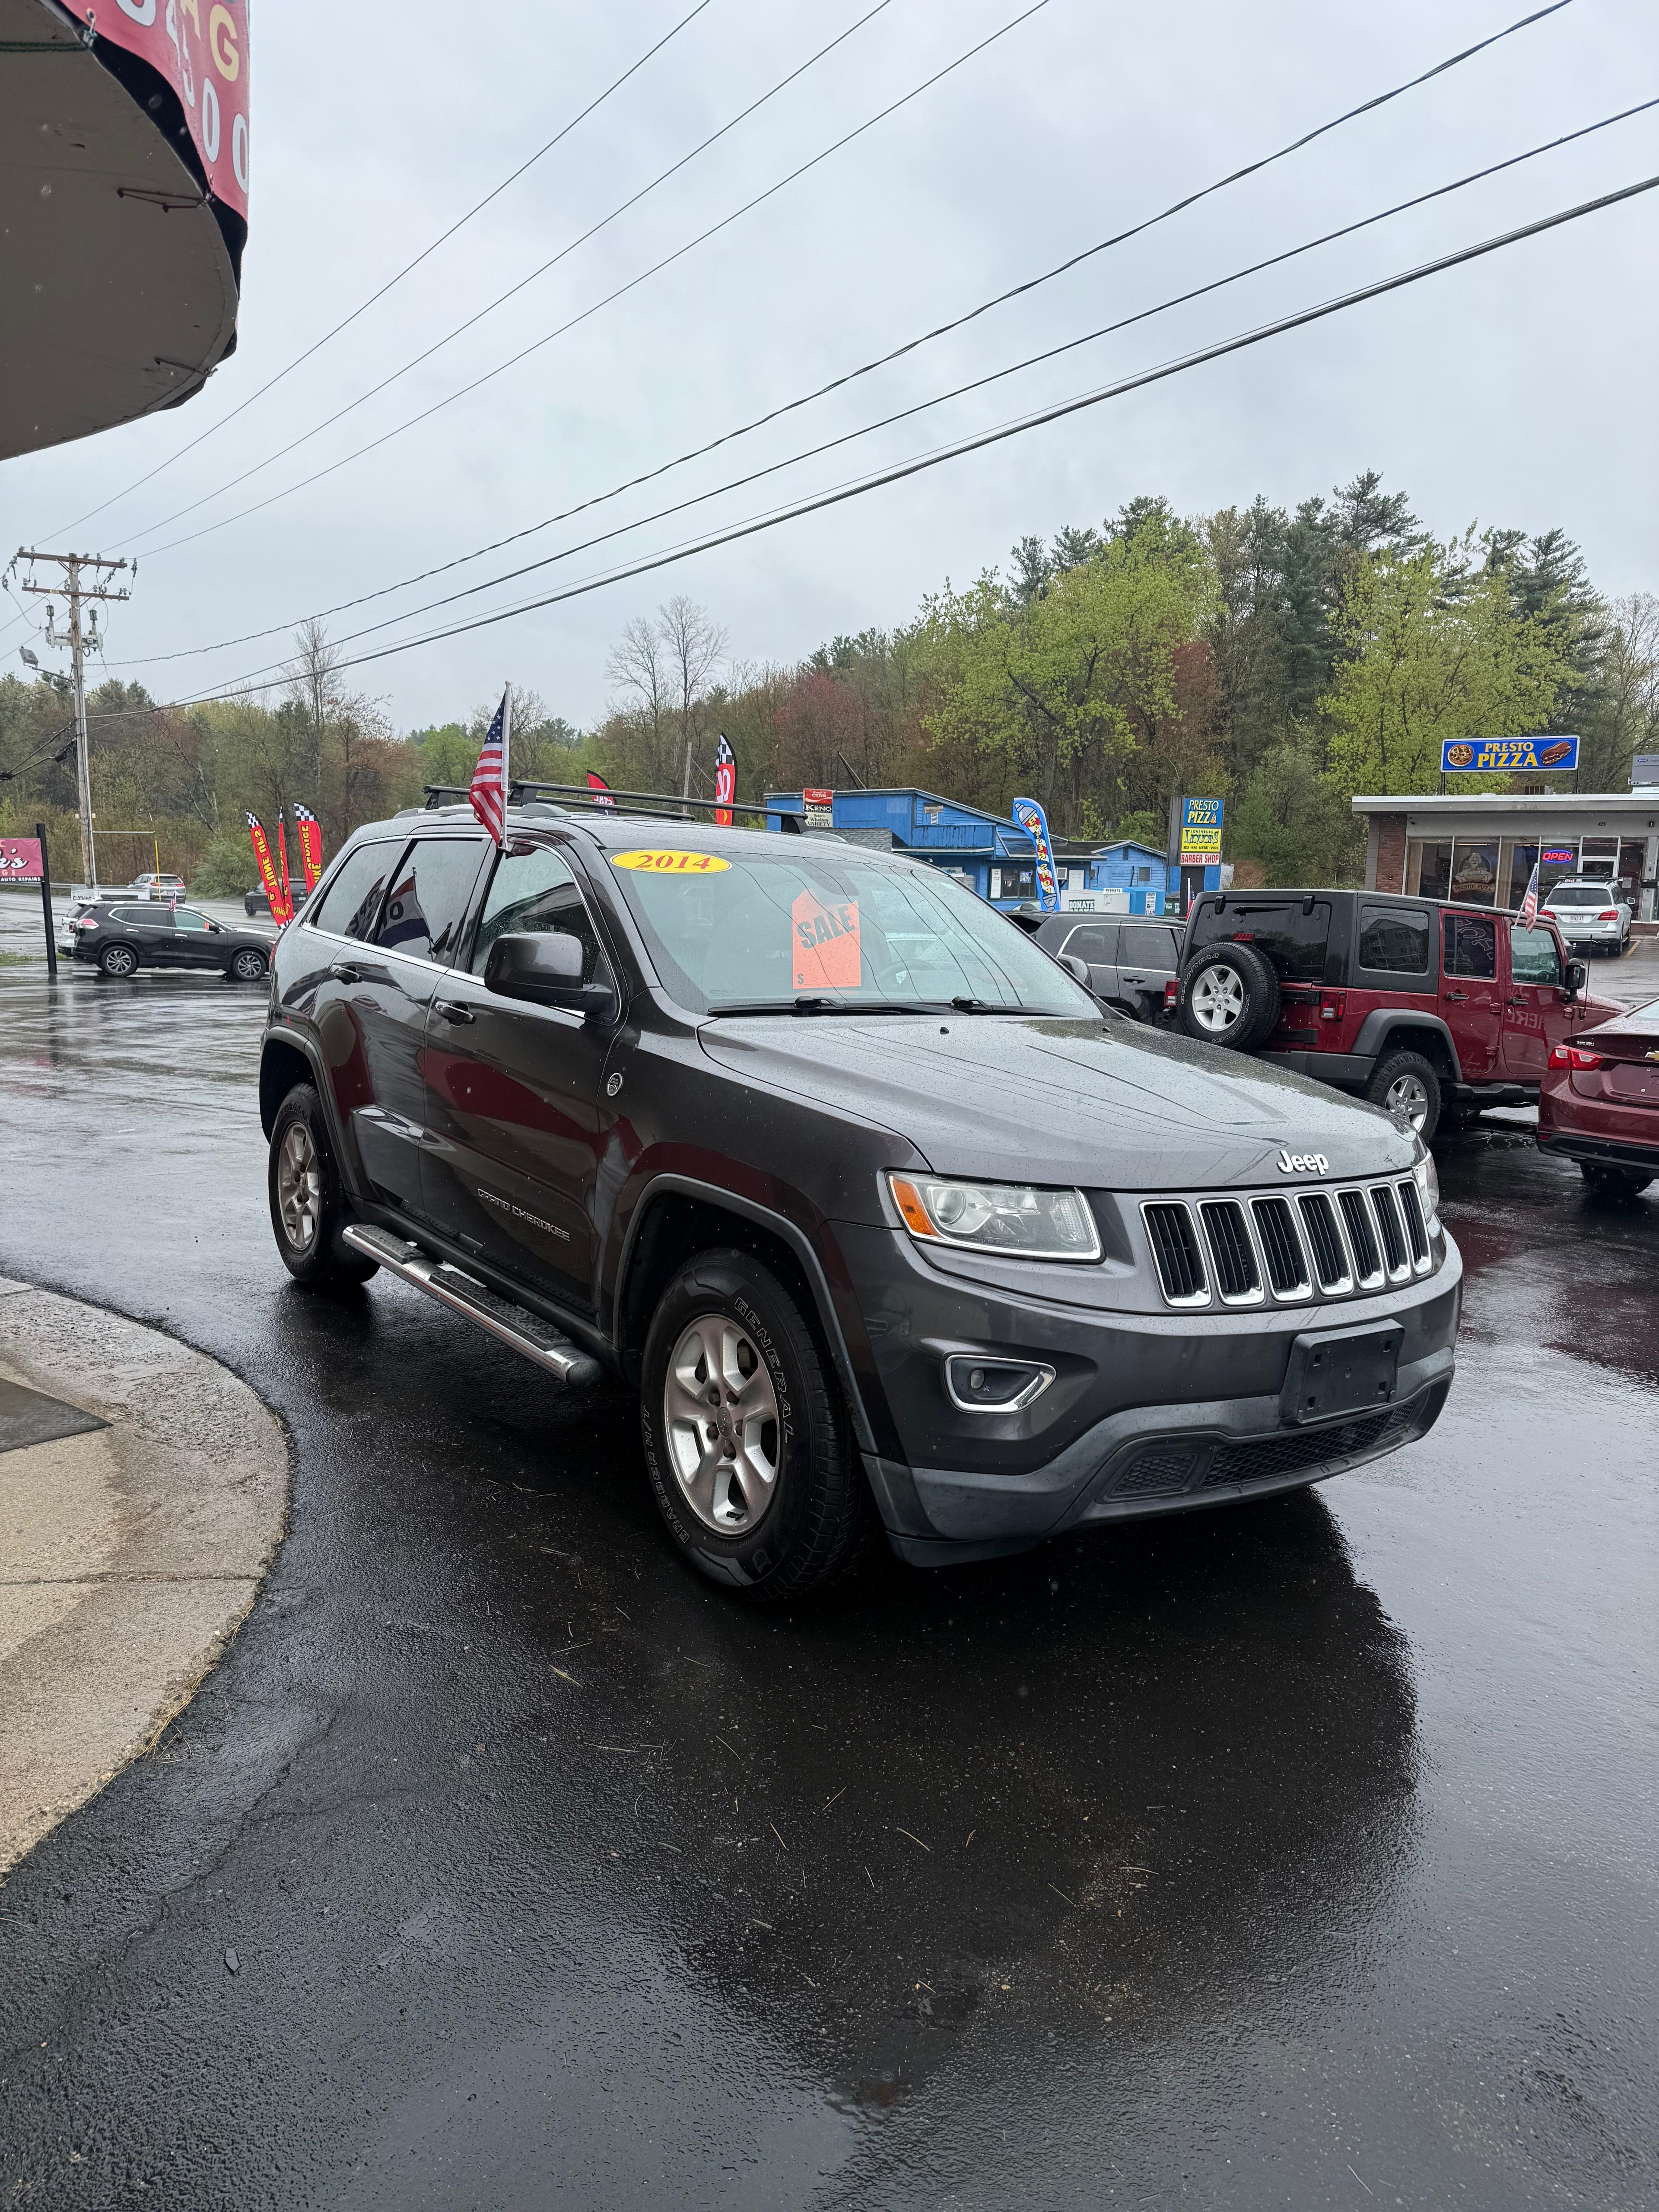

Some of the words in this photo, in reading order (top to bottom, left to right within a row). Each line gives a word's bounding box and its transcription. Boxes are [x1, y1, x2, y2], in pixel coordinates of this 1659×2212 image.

[1484, 742, 1534, 752] PRESTO
[1478, 752, 1539, 768] PIZZA
[1189, 800, 1219, 811] PRESTO
[635, 855, 711, 869] 2014
[1181, 854, 1203, 863] BARBER
[1205, 855, 1219, 863] SHOP
[1542, 852, 1573, 861] OPEN
[1069, 900, 1094, 909] DONATE
[797, 905, 856, 949] SALE
[1181, 953, 1219, 1004] GOODYEAR
[1276, 1150, 1329, 1176] Jeep
[512, 1205, 570, 1242] CHEROKEE
[734, 1297, 794, 1443] GENERAL
[648, 1451, 690, 1543] GRABBER
